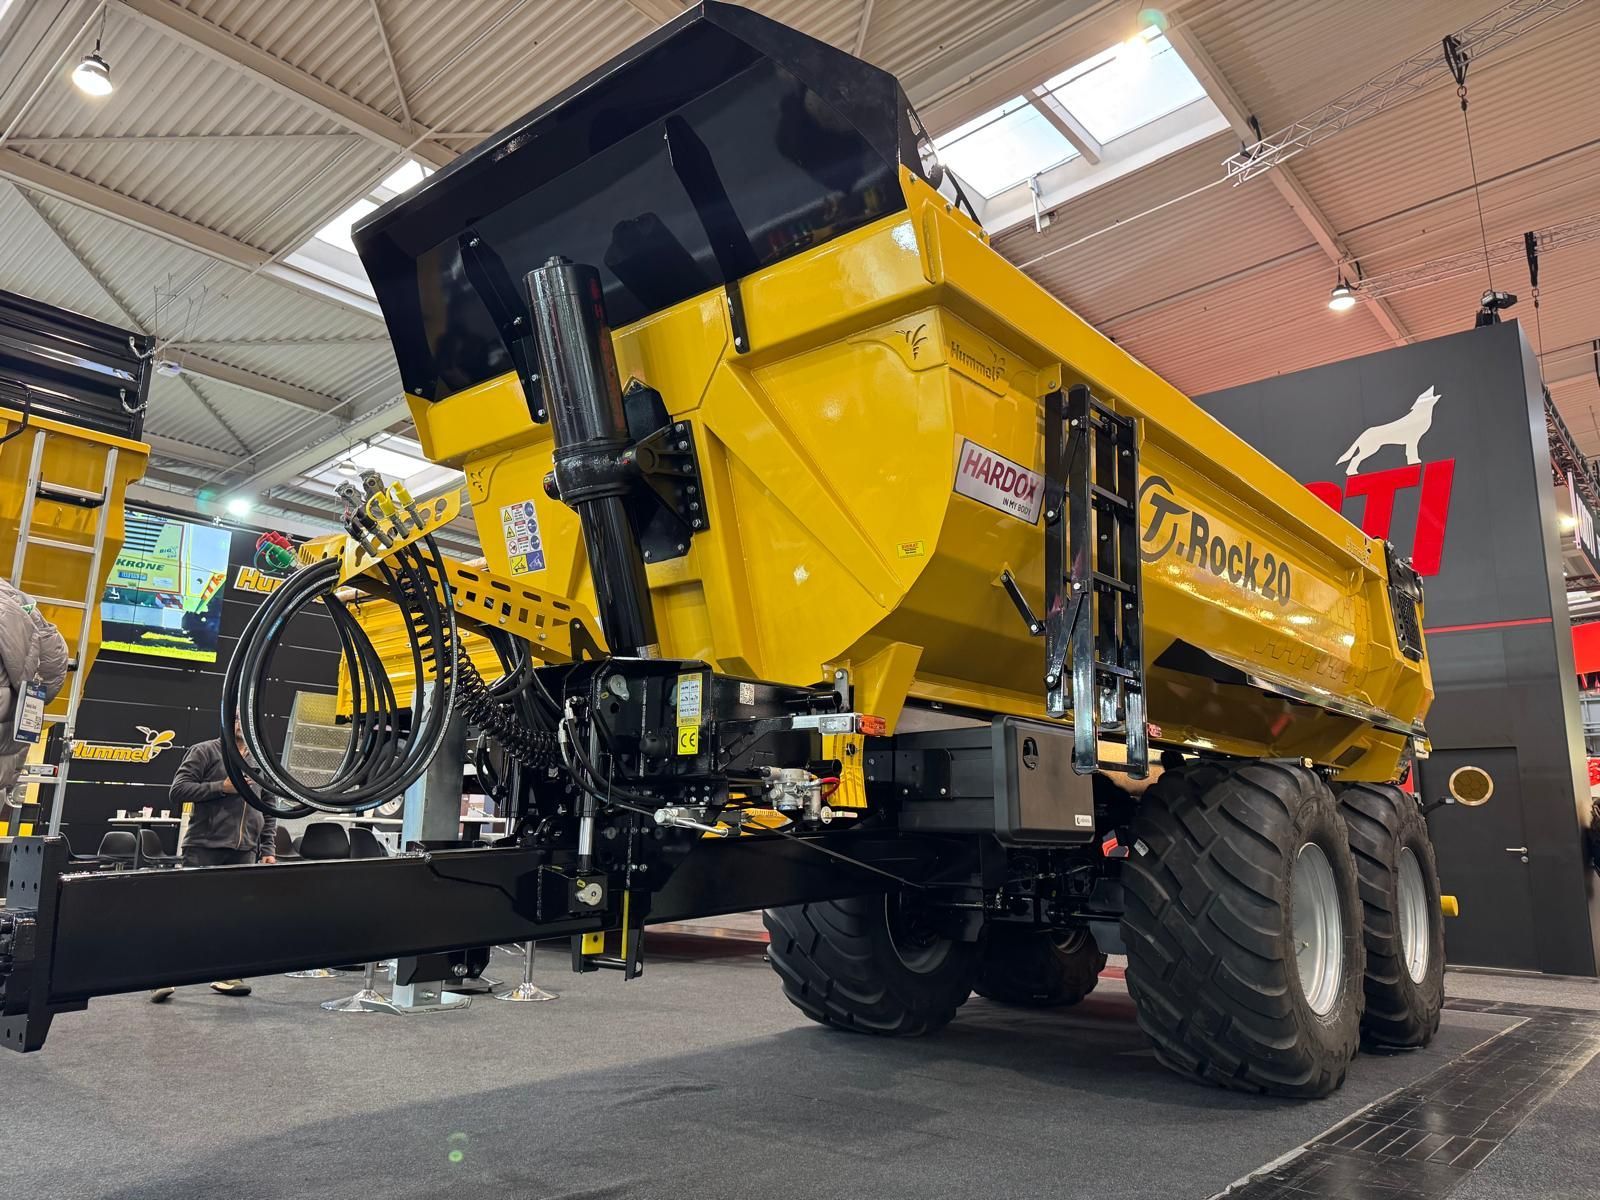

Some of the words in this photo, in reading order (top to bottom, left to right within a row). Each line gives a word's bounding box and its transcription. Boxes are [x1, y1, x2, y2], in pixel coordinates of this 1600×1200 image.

[951, 341, 995, 382] Hummel
[963, 449, 1039, 504] HARDOX
[1009, 500, 1018, 510] MY
[1017, 503, 1032, 516] BODY
[115, 558, 165, 571] KRONE
[1261, 552, 1291, 607] 20
[680, 732, 696, 748] CE
